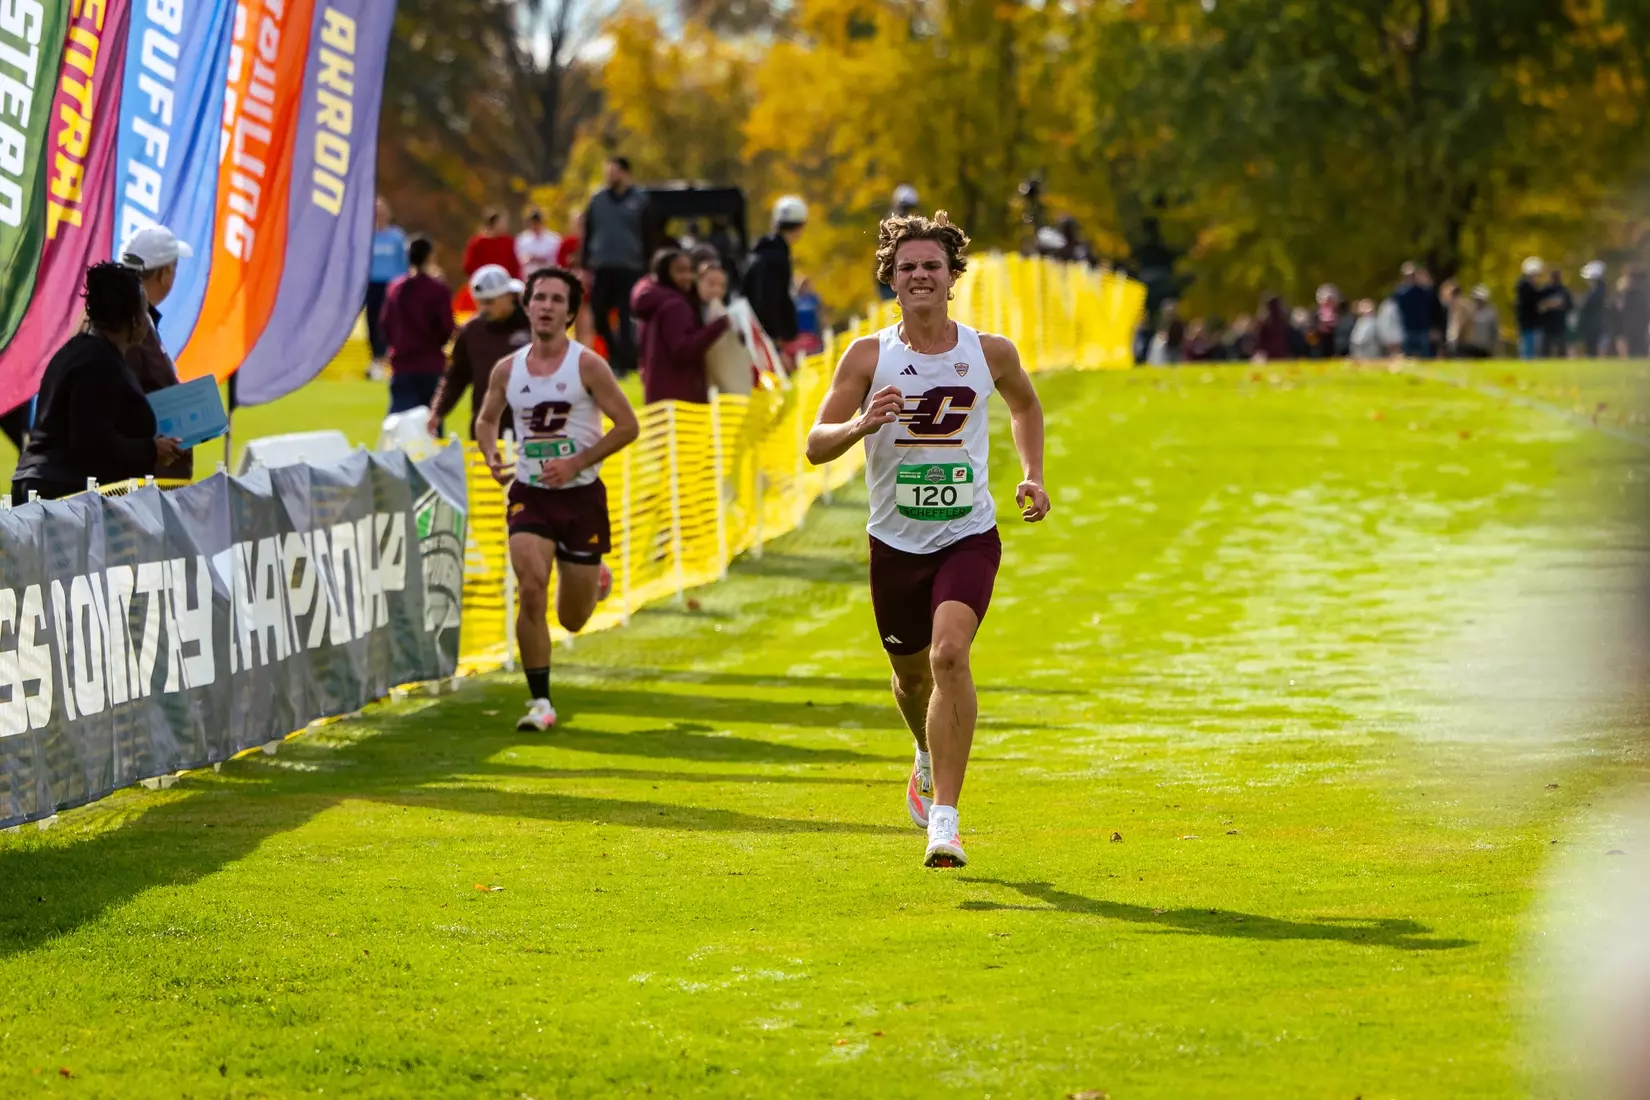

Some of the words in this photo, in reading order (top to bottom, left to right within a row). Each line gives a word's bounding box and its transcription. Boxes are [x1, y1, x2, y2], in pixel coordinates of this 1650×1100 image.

[113, 0, 184, 262] BUFFAL
[312, 7, 357, 216] AKRON
[903, 507, 967, 517] SCHEFFLER
[912, 486, 957, 506] 120
